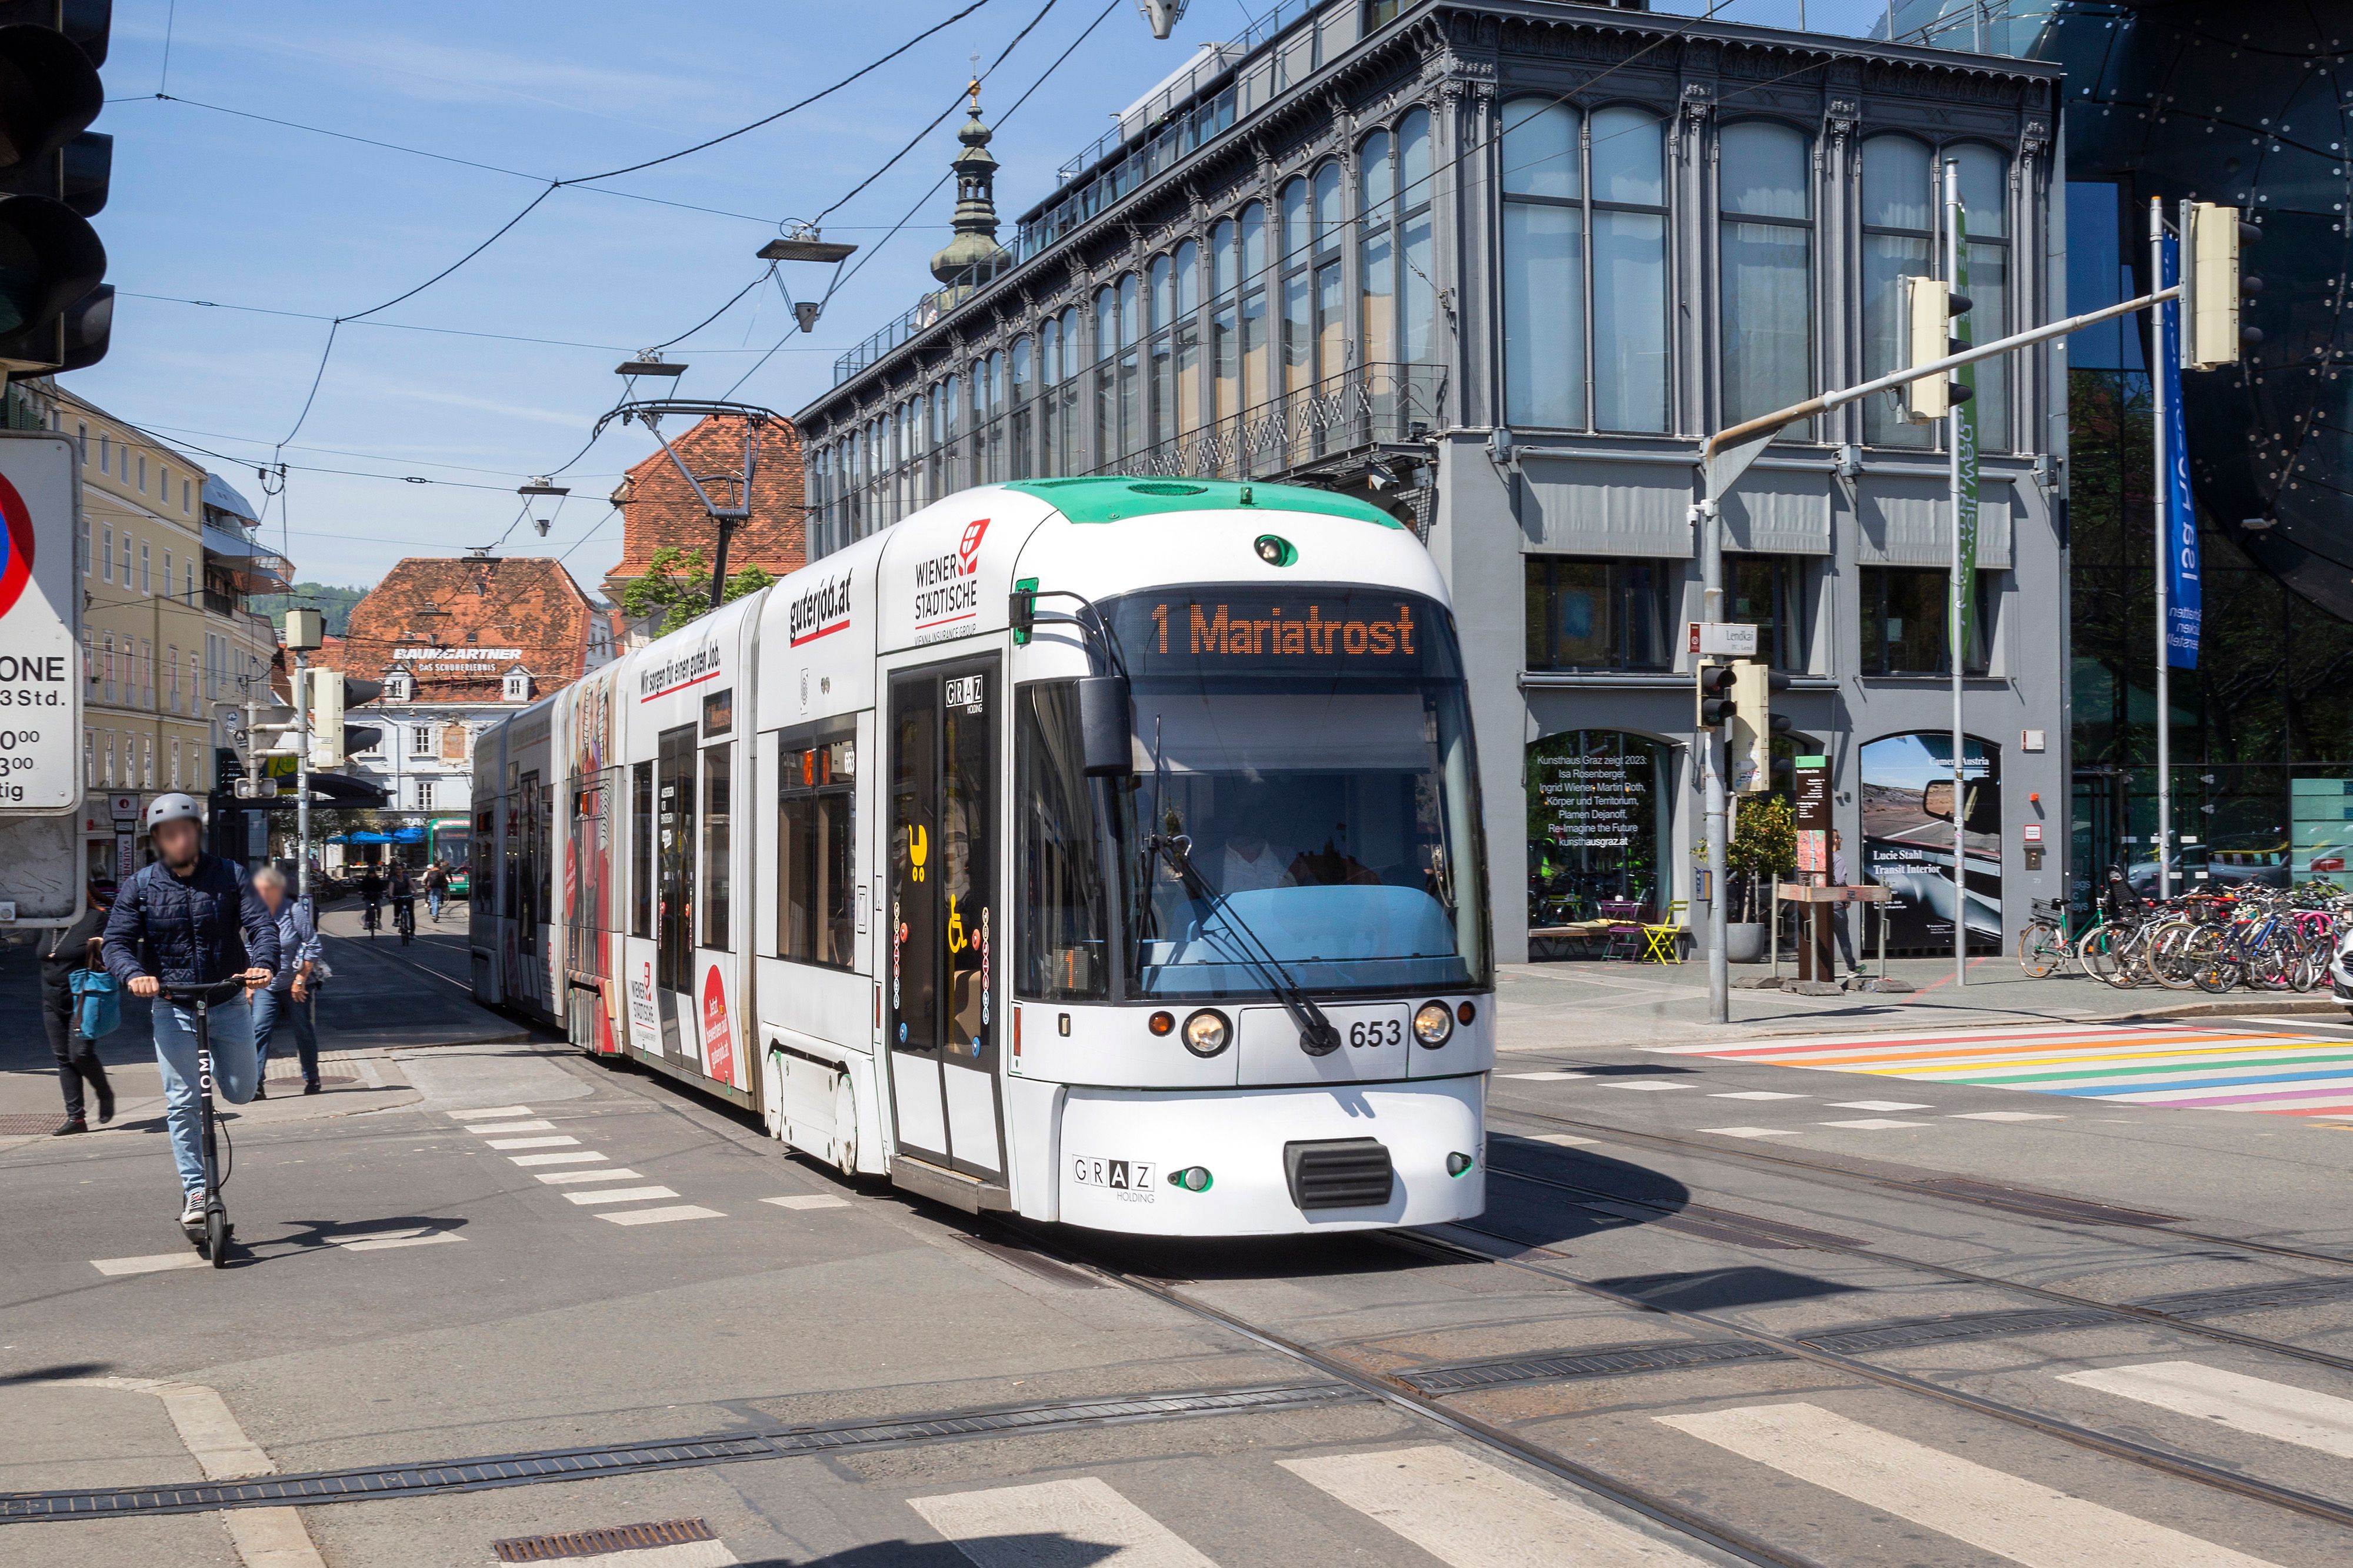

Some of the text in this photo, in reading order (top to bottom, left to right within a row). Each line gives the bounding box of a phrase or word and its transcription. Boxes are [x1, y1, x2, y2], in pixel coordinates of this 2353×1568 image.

[916, 553, 956, 589] WIENER
[915, 579, 977, 620] STÄDTISCHE
[790, 567, 853, 644] guterjob.at
[915, 623, 976, 646] VIENNA INSURANCE GROUP
[1151, 604, 1414, 654] 1 Mariatrost
[1726, 630, 1754, 641] Lendkai
[393, 649, 522, 659] BAUMGARTNER
[641, 669, 649, 695] Wir
[649, 668, 665, 695] sorgen
[675, 654, 689, 682] einen
[690, 647, 706, 682] guten
[708, 638, 721, 670] Job.
[947, 678, 981, 705] GRAZ
[18, 690, 65, 706] Std.
[966, 703, 983, 714] HOLDING
[845, 750, 855, 773] 653
[1537, 756, 1647, 766] Kunsthaus Graz zeigt 2023:
[1929, 757, 1990, 765] Camer Austria
[1559, 769, 1627, 780] Isa Rosenberger,
[1539, 783, 1562, 794] Ingrid
[1597, 783, 1622, 792] Martin
[1624, 783, 1646, 792] Roth,
[1547, 796, 1639, 806] Körper und Territorium,
[1559, 810, 1628, 820] Plamen Dejanoff,
[1548, 823, 1638, 834] Re-Imagine the Future
[1559, 838, 1628, 848] kunsthausgraz.at
[1873, 850, 1922, 860] Lucie Stahl
[1873, 864, 1941, 874] Transit Interior
[1350, 1019, 1401, 1048] 653
[1075, 1159, 1149, 1188] GRAZ
[1117, 1191, 1155, 1203] HOLDING
